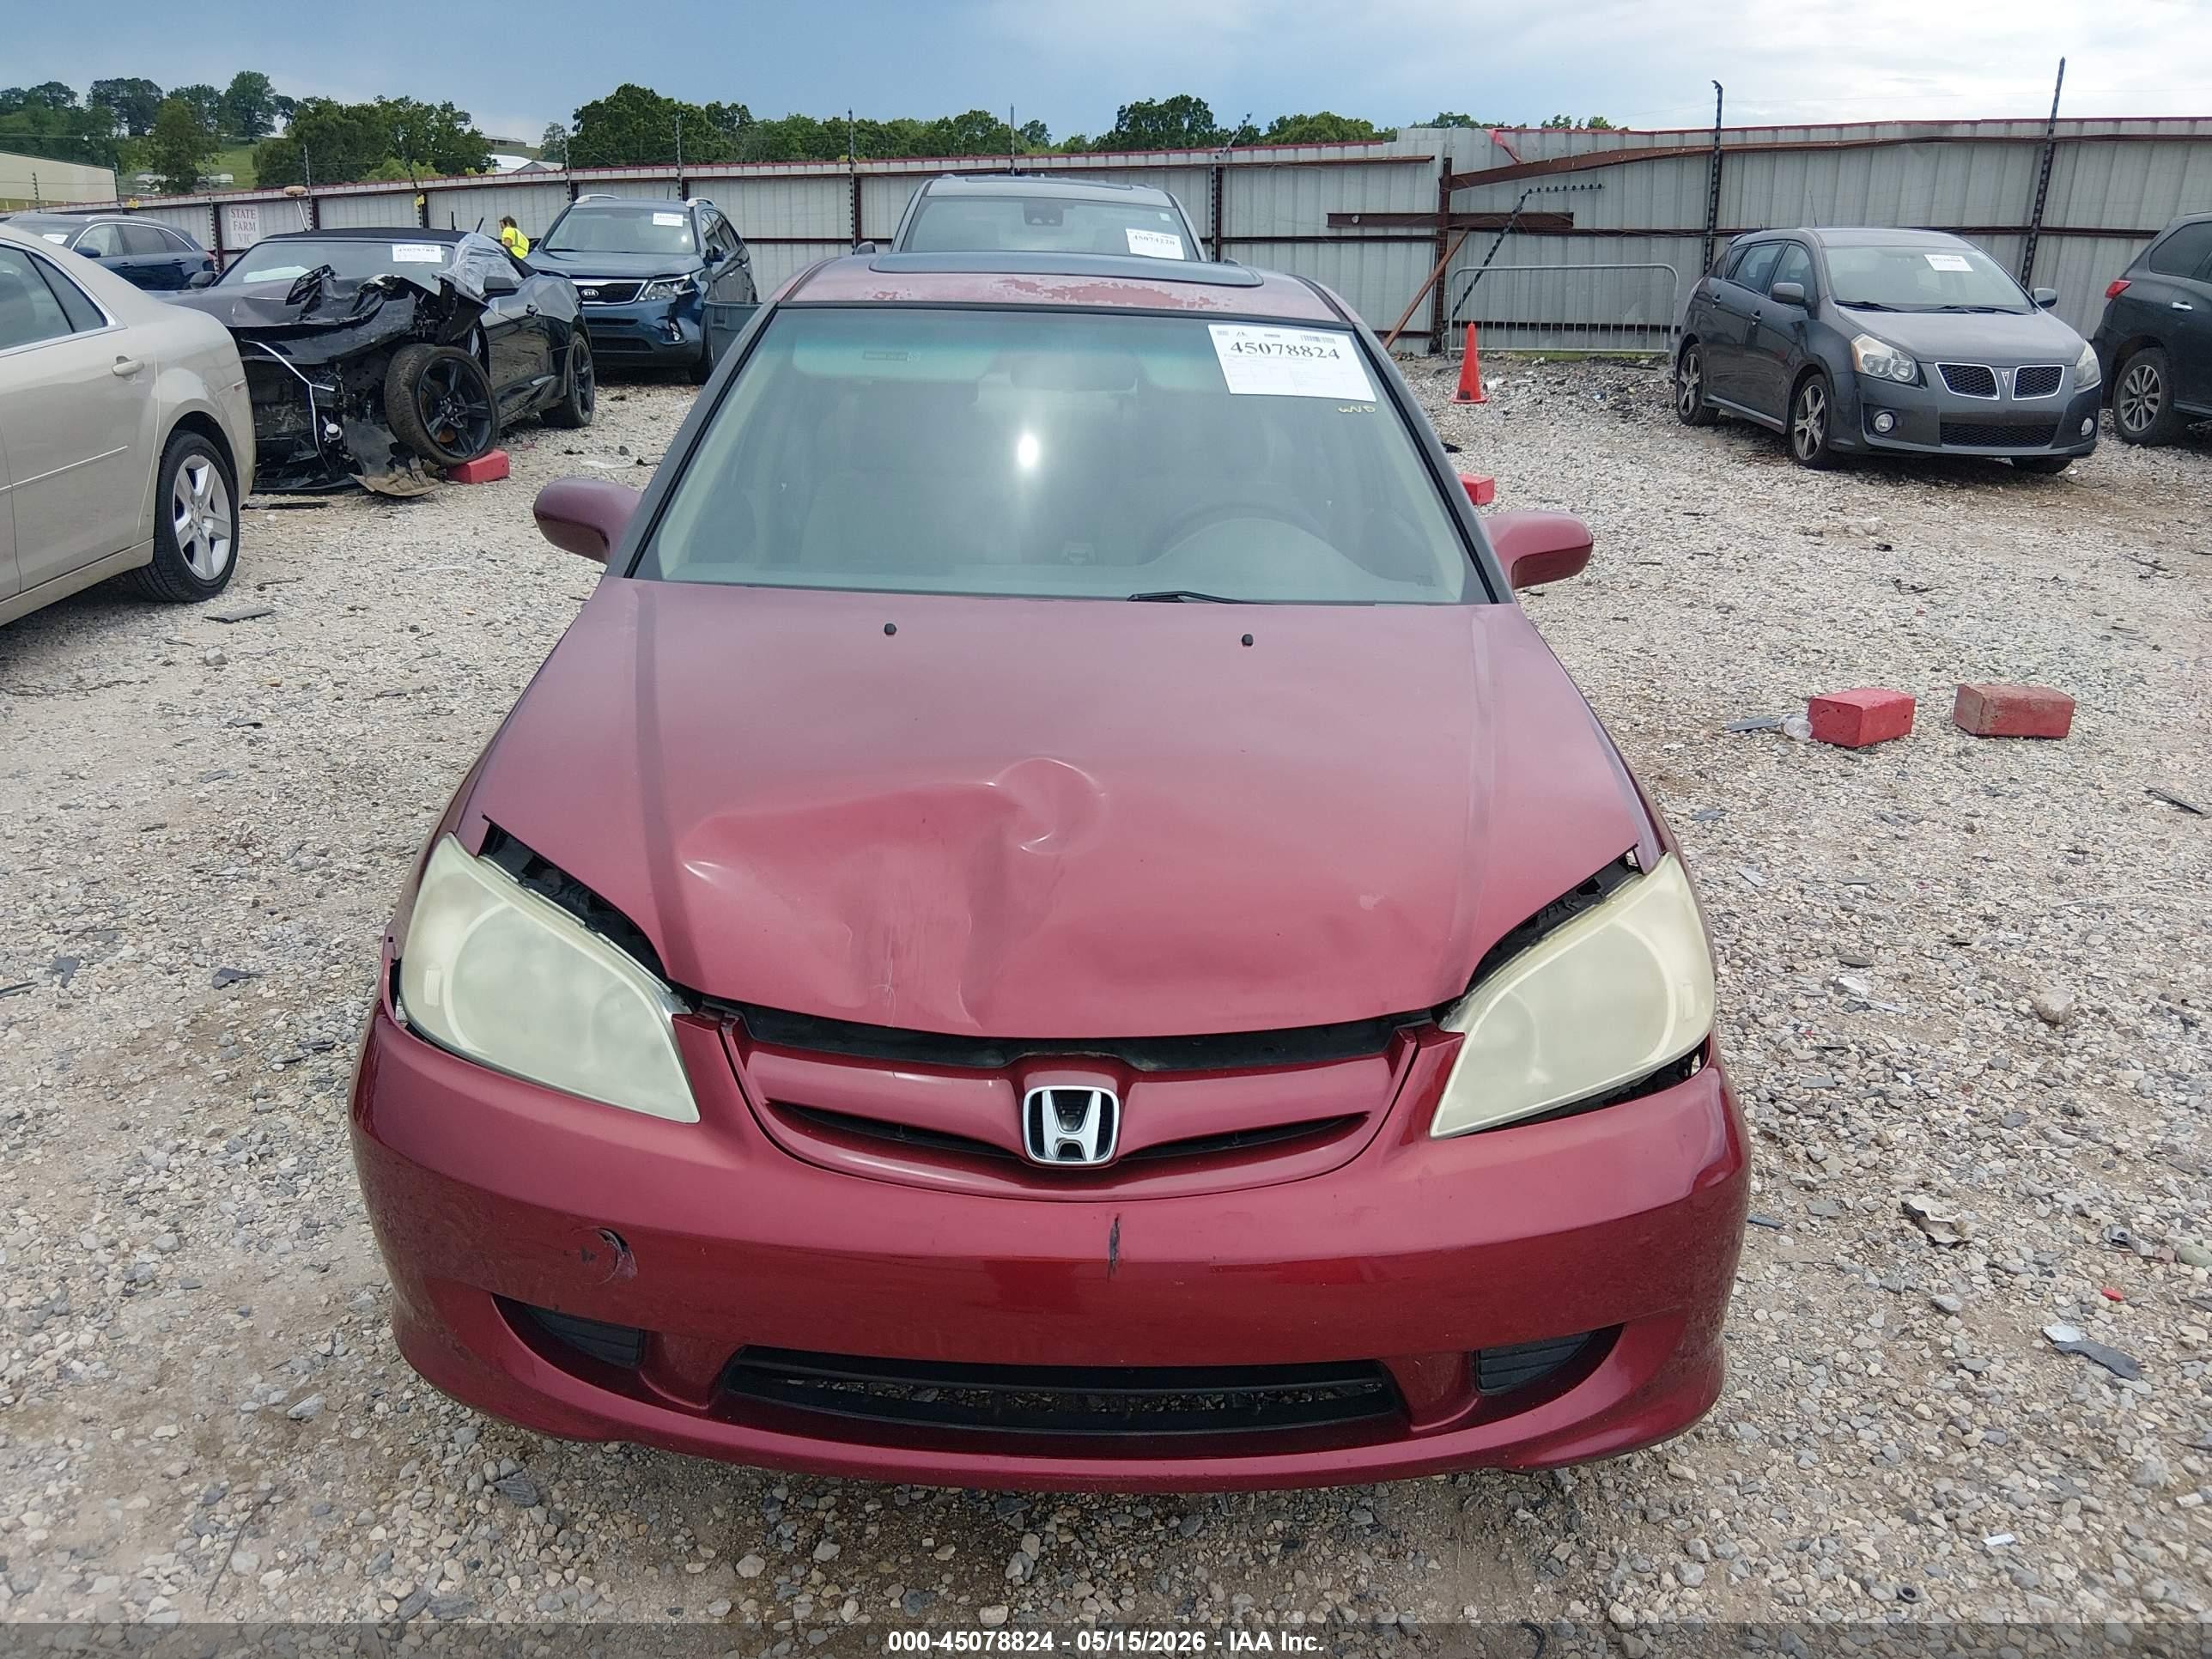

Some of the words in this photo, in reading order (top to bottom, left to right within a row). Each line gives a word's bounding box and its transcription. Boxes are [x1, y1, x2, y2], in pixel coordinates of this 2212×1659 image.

[231, 207, 257, 220] STATE
[233, 221, 256, 232] FARM
[237, 233, 253, 245] VIC
[1230, 341, 1340, 361] 45078824
